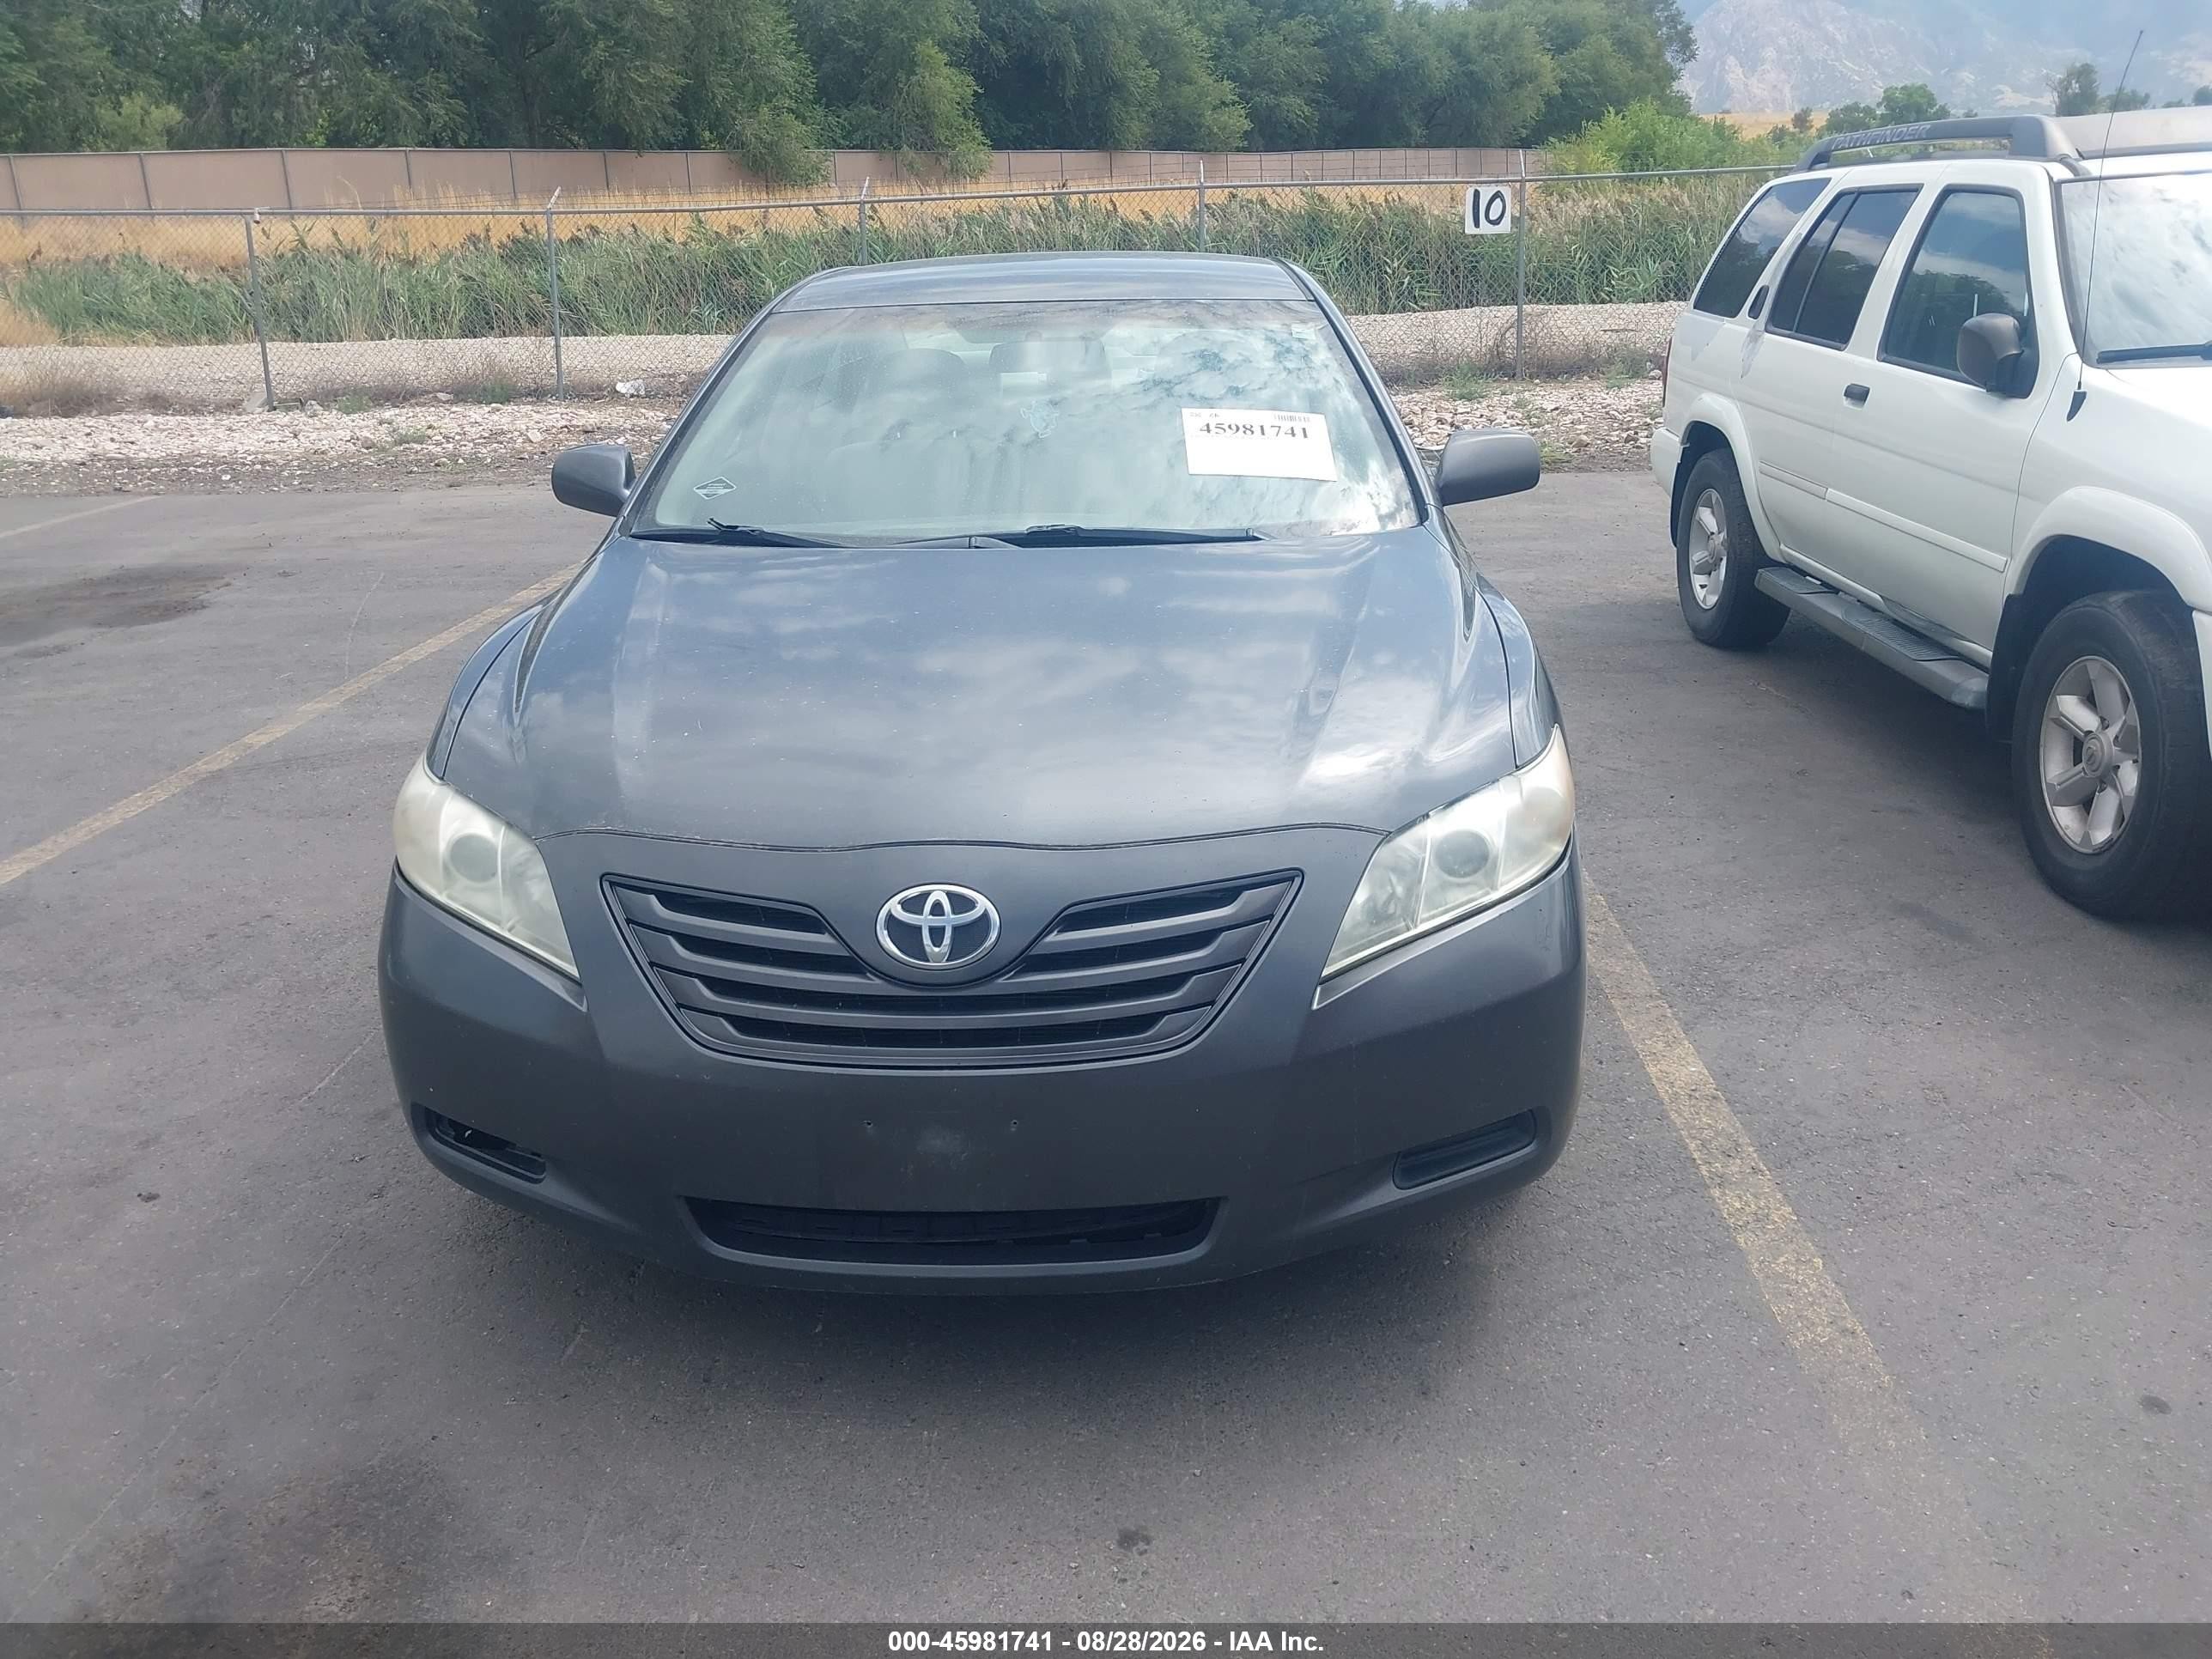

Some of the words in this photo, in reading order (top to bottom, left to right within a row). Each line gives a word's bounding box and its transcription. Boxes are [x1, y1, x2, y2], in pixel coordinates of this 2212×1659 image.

[1831, 125, 1931, 149] PATHFINDER
[1473, 188, 1507, 229] 10
[1200, 422, 1308, 439] 45981741
